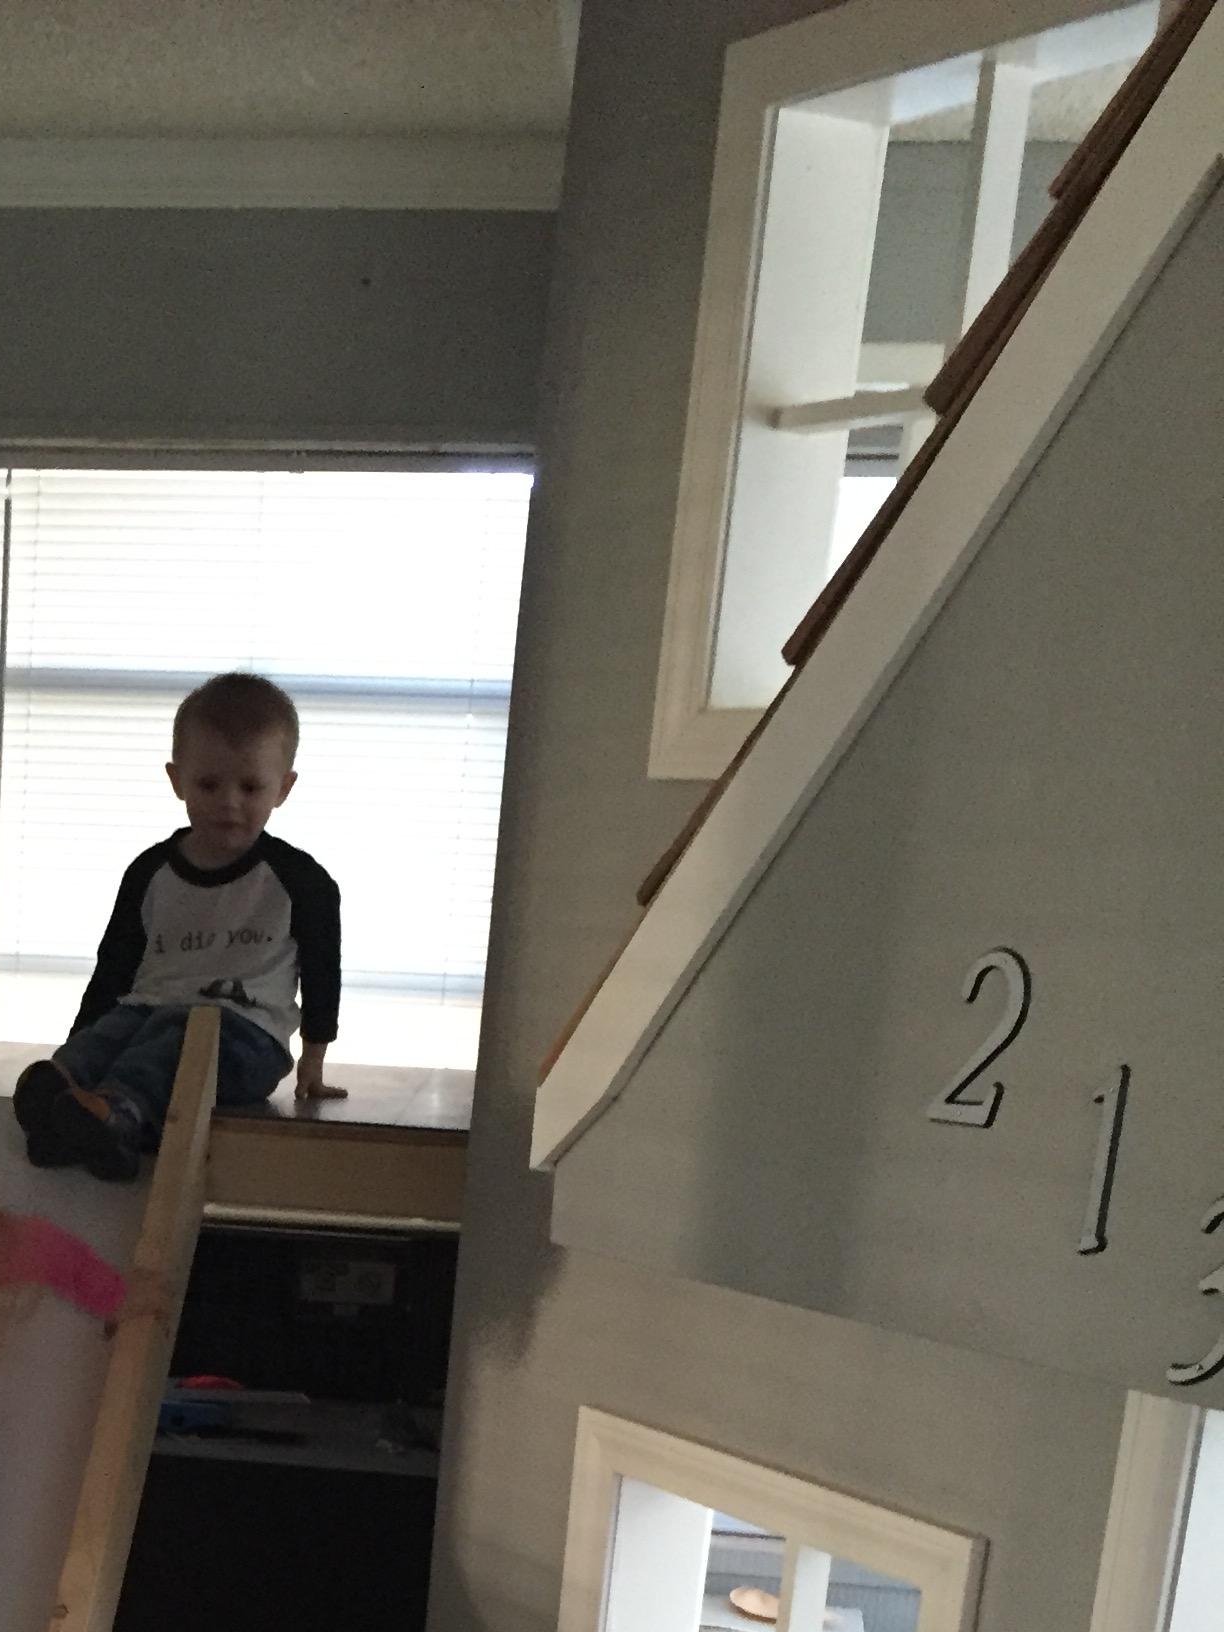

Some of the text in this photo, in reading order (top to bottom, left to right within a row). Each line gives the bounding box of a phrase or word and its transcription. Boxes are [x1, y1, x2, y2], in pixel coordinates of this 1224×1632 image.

[154, 933, 167, 954] i
[224, 927, 274, 950] you.
[926, 945, 1032, 1129] 2
[1077, 1063, 1132, 1256] 1
